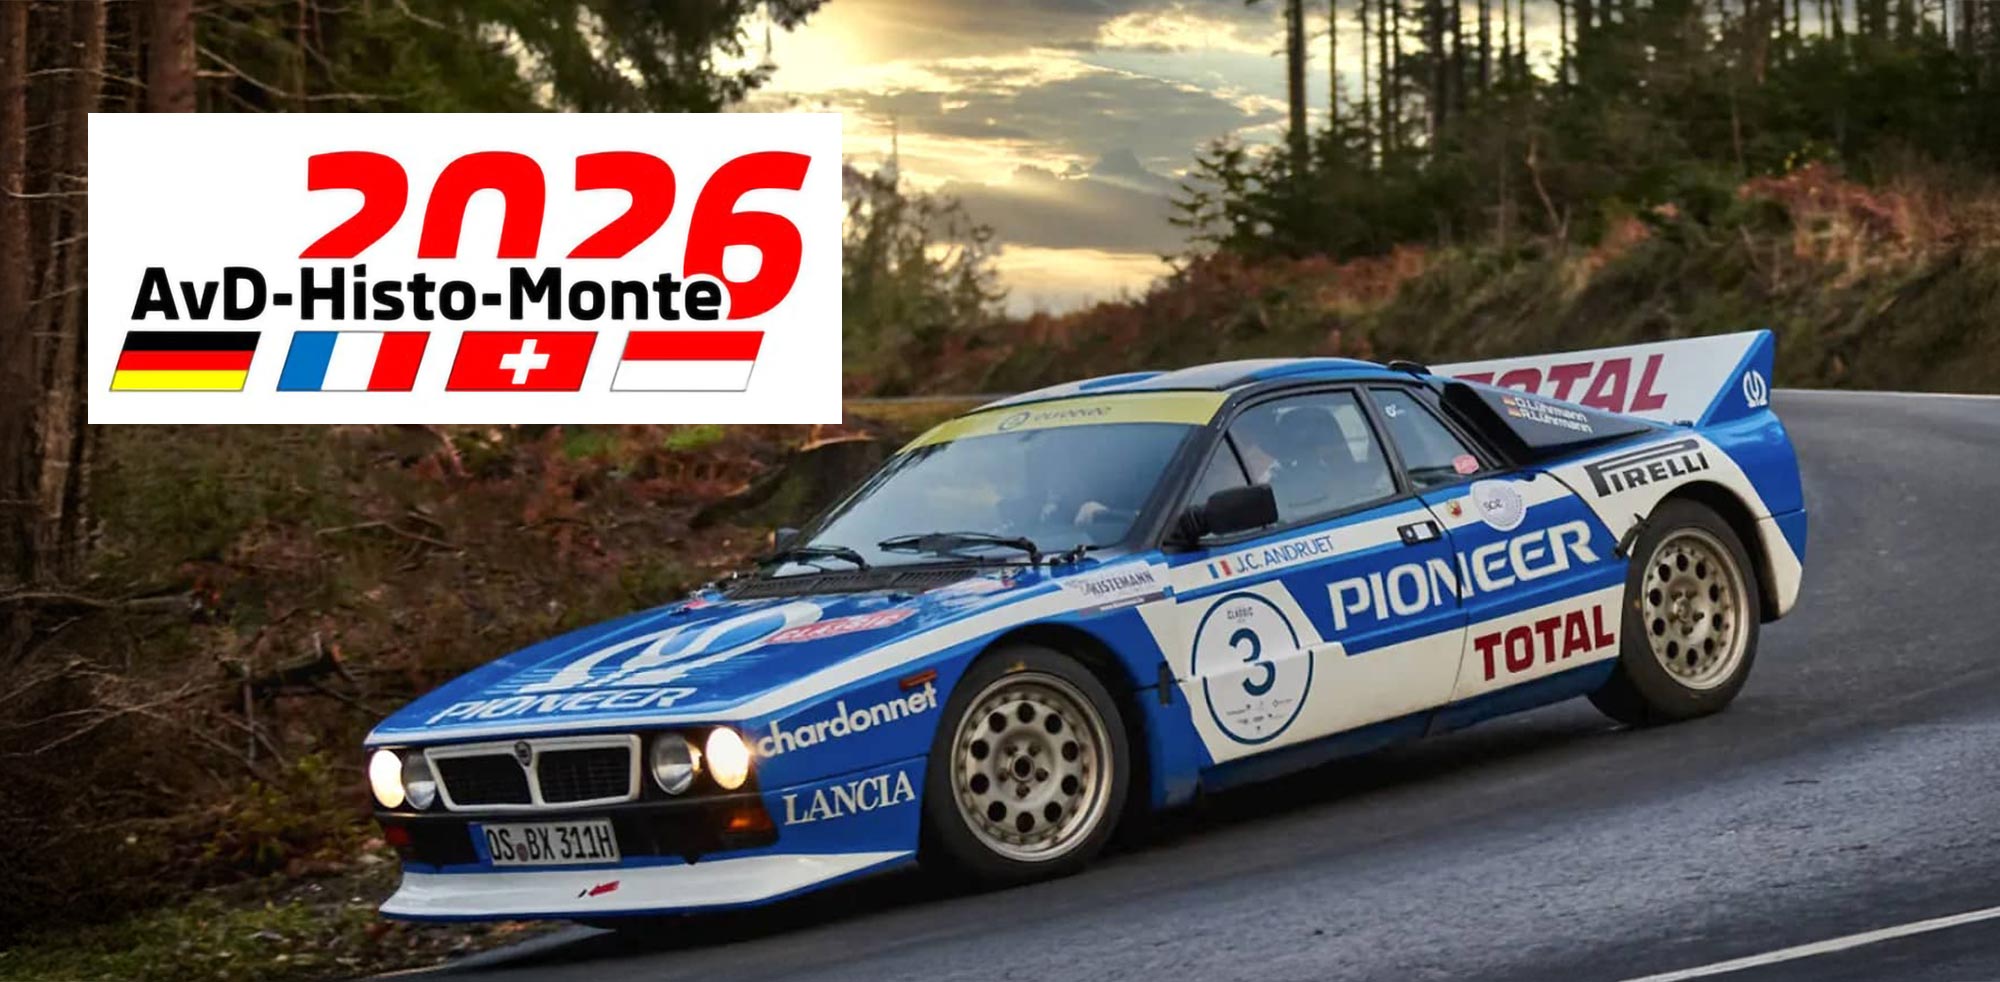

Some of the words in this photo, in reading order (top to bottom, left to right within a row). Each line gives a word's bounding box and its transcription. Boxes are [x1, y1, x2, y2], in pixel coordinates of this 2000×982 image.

[1452, 353, 1668, 414] TAL
[1584, 438, 1710, 498] PIRELLI
[1264, 535, 1335, 567] ANDRUET
[1326, 519, 1601, 632] PIONEER
[1228, 627, 1277, 697] 3
[1473, 603, 1615, 682] TOTAL
[425, 686, 698, 726] PIONEER
[756, 681, 938, 758] chardonnet
[781, 770, 916, 826] LANCIA
[486, 827, 516, 861] OS
[524, 826, 556, 861] BX
[555, 824, 615, 860] 311H
